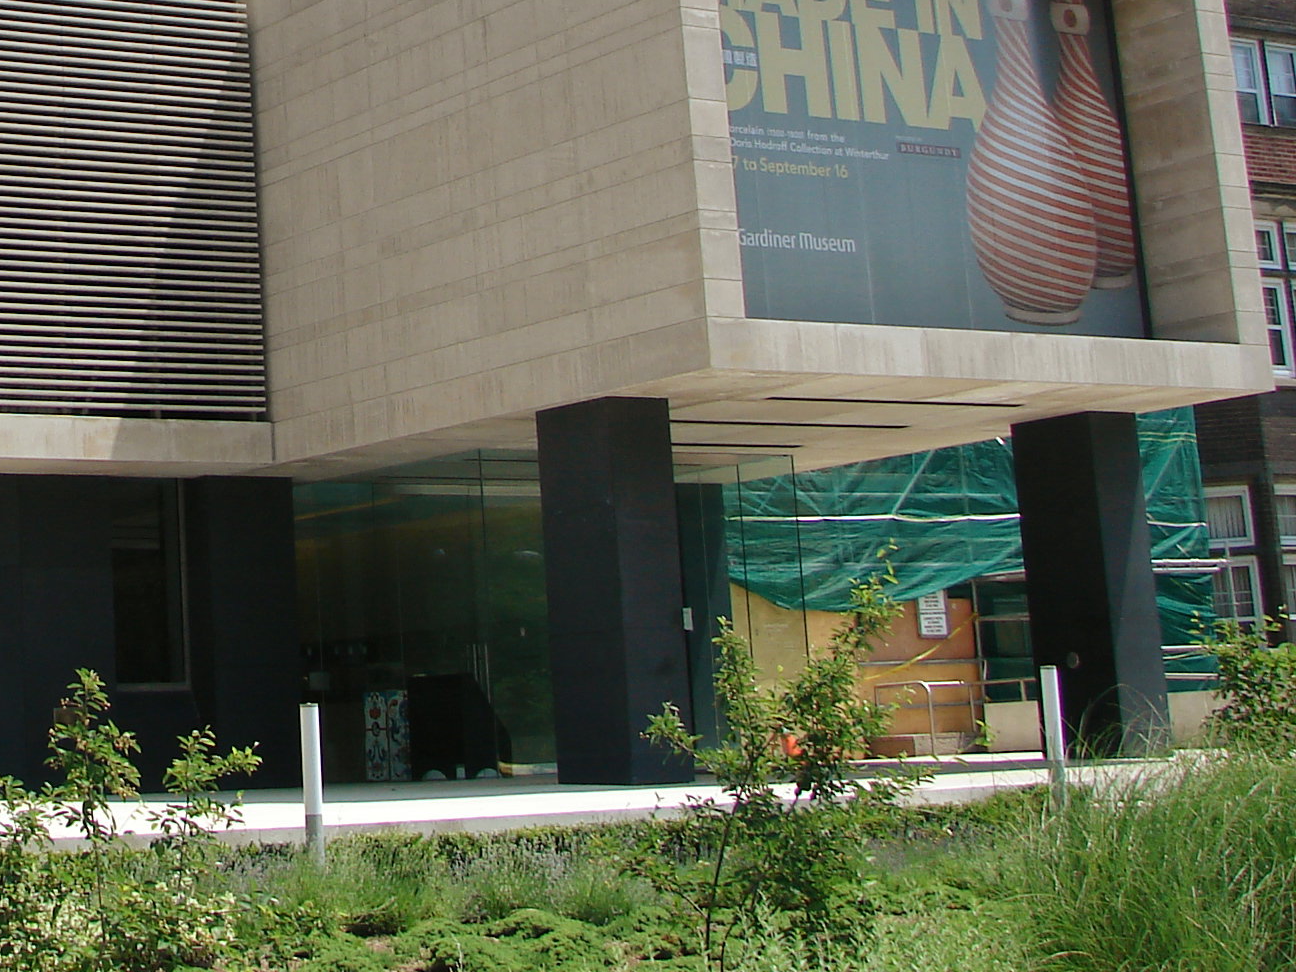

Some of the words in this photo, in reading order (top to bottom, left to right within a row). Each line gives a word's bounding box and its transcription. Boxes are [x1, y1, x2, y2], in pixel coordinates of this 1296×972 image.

[807, 130, 828, 142] from
[830, 133, 845, 144] the
[789, 141, 833, 156] Collection
[834, 146, 844, 157] at
[743, 158, 757, 171] to
[759, 156, 832, 177] September
[835, 163, 849, 178] 16
[799, 232, 856, 253] Museum
